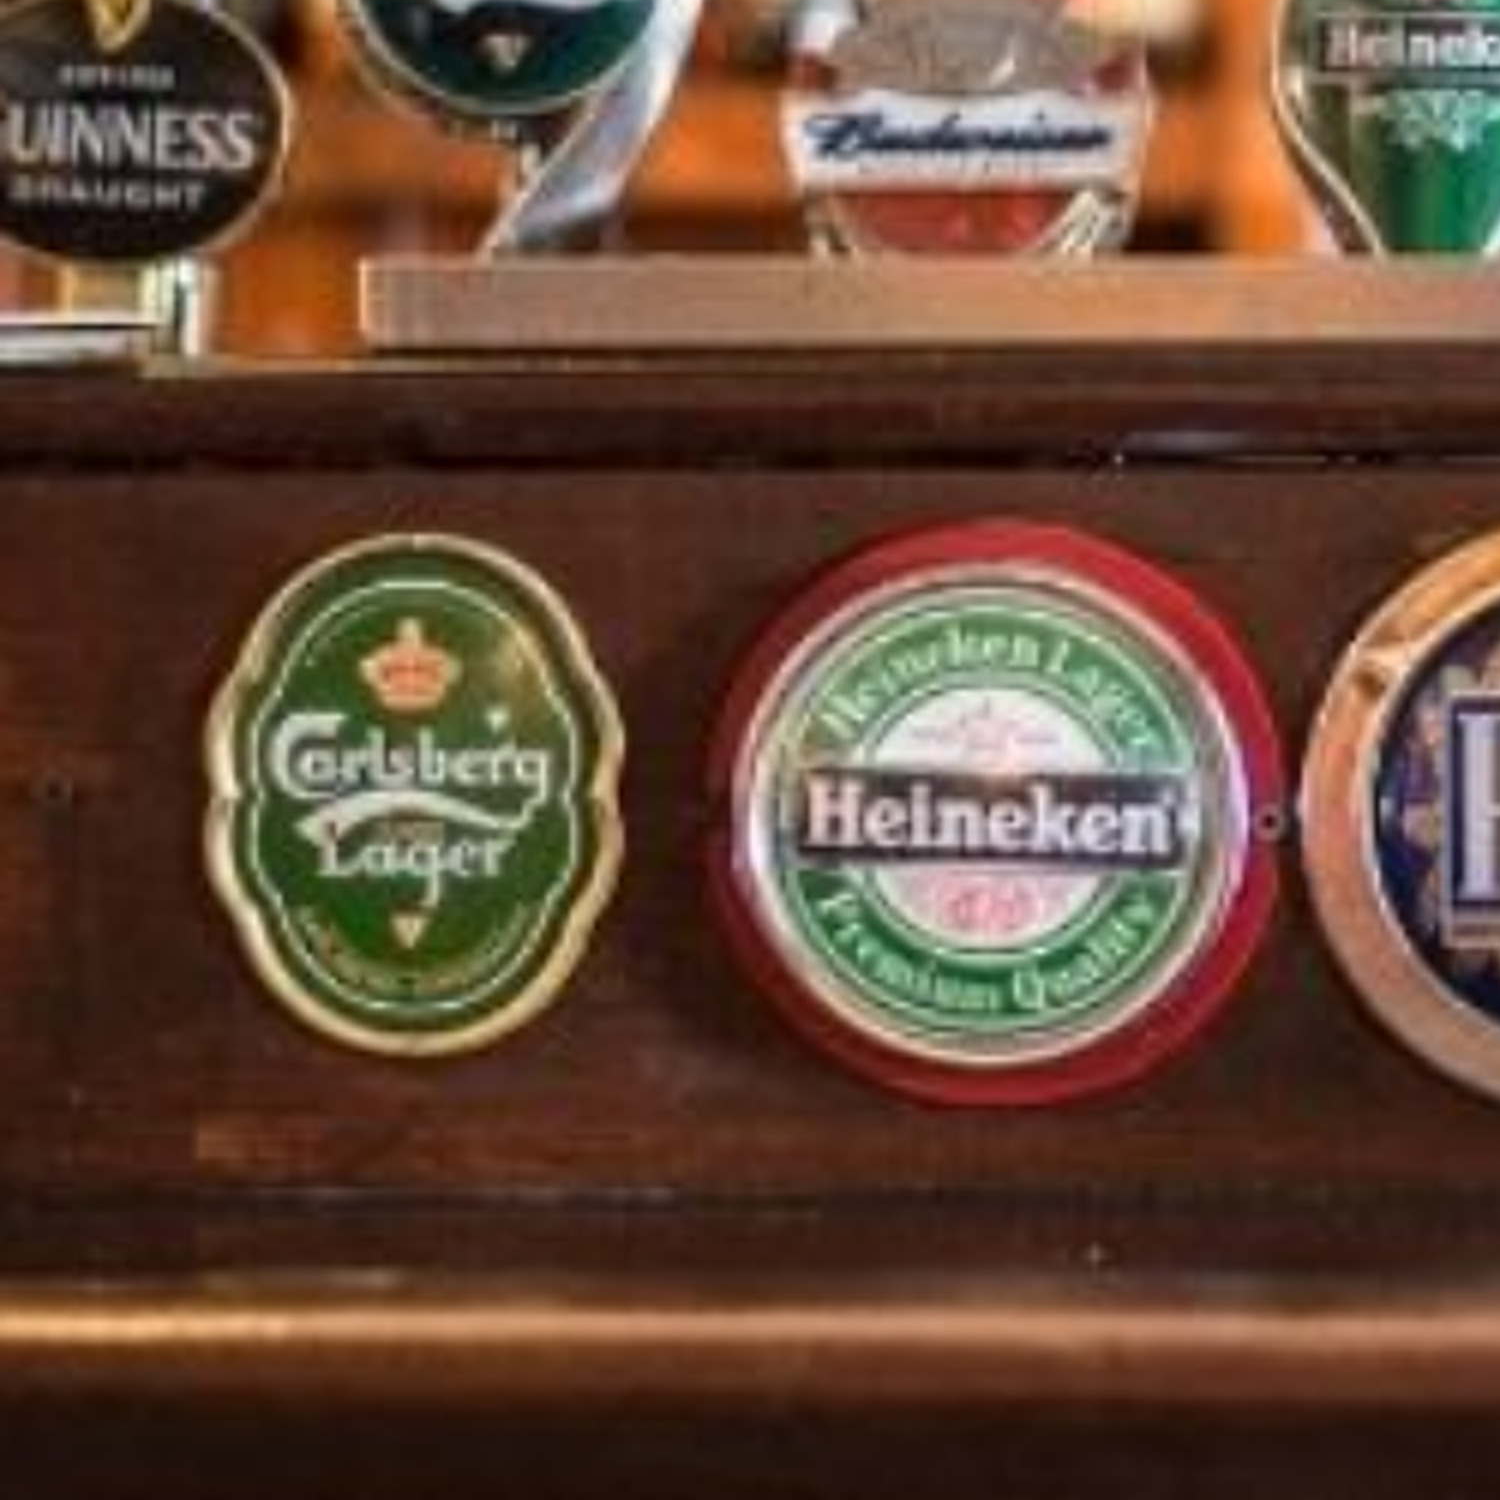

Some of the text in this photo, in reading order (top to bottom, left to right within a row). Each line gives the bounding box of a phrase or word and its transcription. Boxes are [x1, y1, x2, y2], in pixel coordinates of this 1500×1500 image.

[0, 102, 256, 171] UINNESS
[265, 705, 550, 825] Carlsberg
[805, 776, 1174, 856] Heineken
[300, 820, 515, 910] Lager
